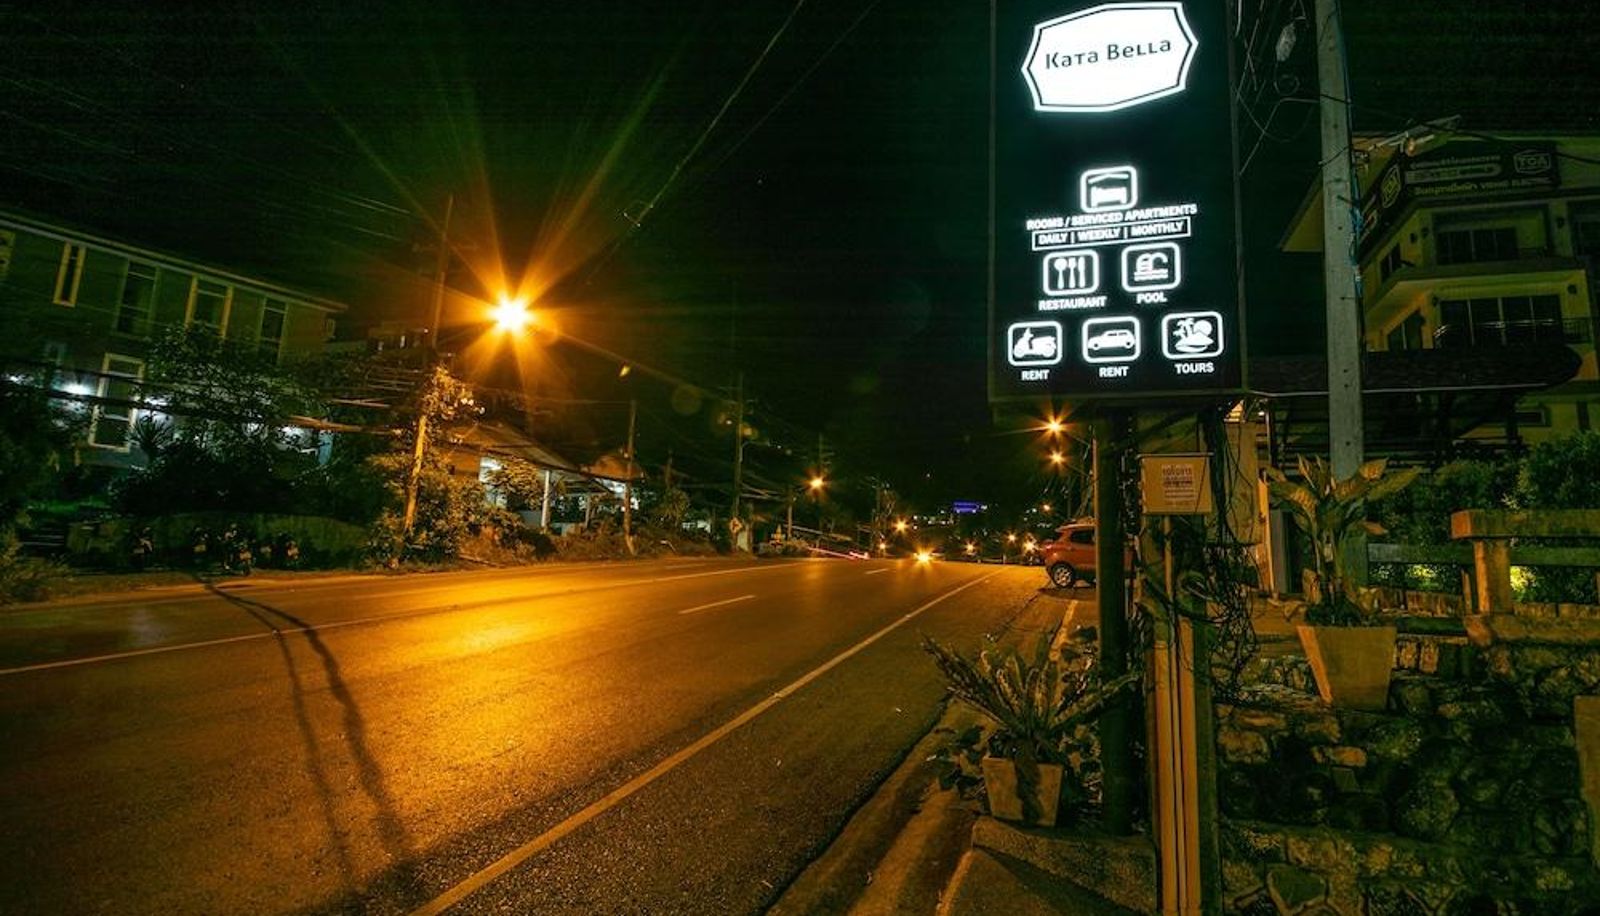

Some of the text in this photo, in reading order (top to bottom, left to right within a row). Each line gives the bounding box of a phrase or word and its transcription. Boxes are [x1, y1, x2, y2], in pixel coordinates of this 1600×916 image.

[1026, 217, 1064, 230] ROOMS
[1072, 212, 1123, 226] SERVICED
[1125, 204, 1198, 221] APARTMENTS
[1038, 233, 1069, 245] DAILY
[1077, 228, 1121, 241] WEEKLY
[1131, 222, 1184, 236] MONTHLY
[1038, 296, 1107, 311] RESTAURANT
[1136, 292, 1167, 304] POOL
[1099, 366, 1129, 377] RENT
[1175, 362, 1214, 374] TOURS
[1021, 369, 1050, 381] RENT
